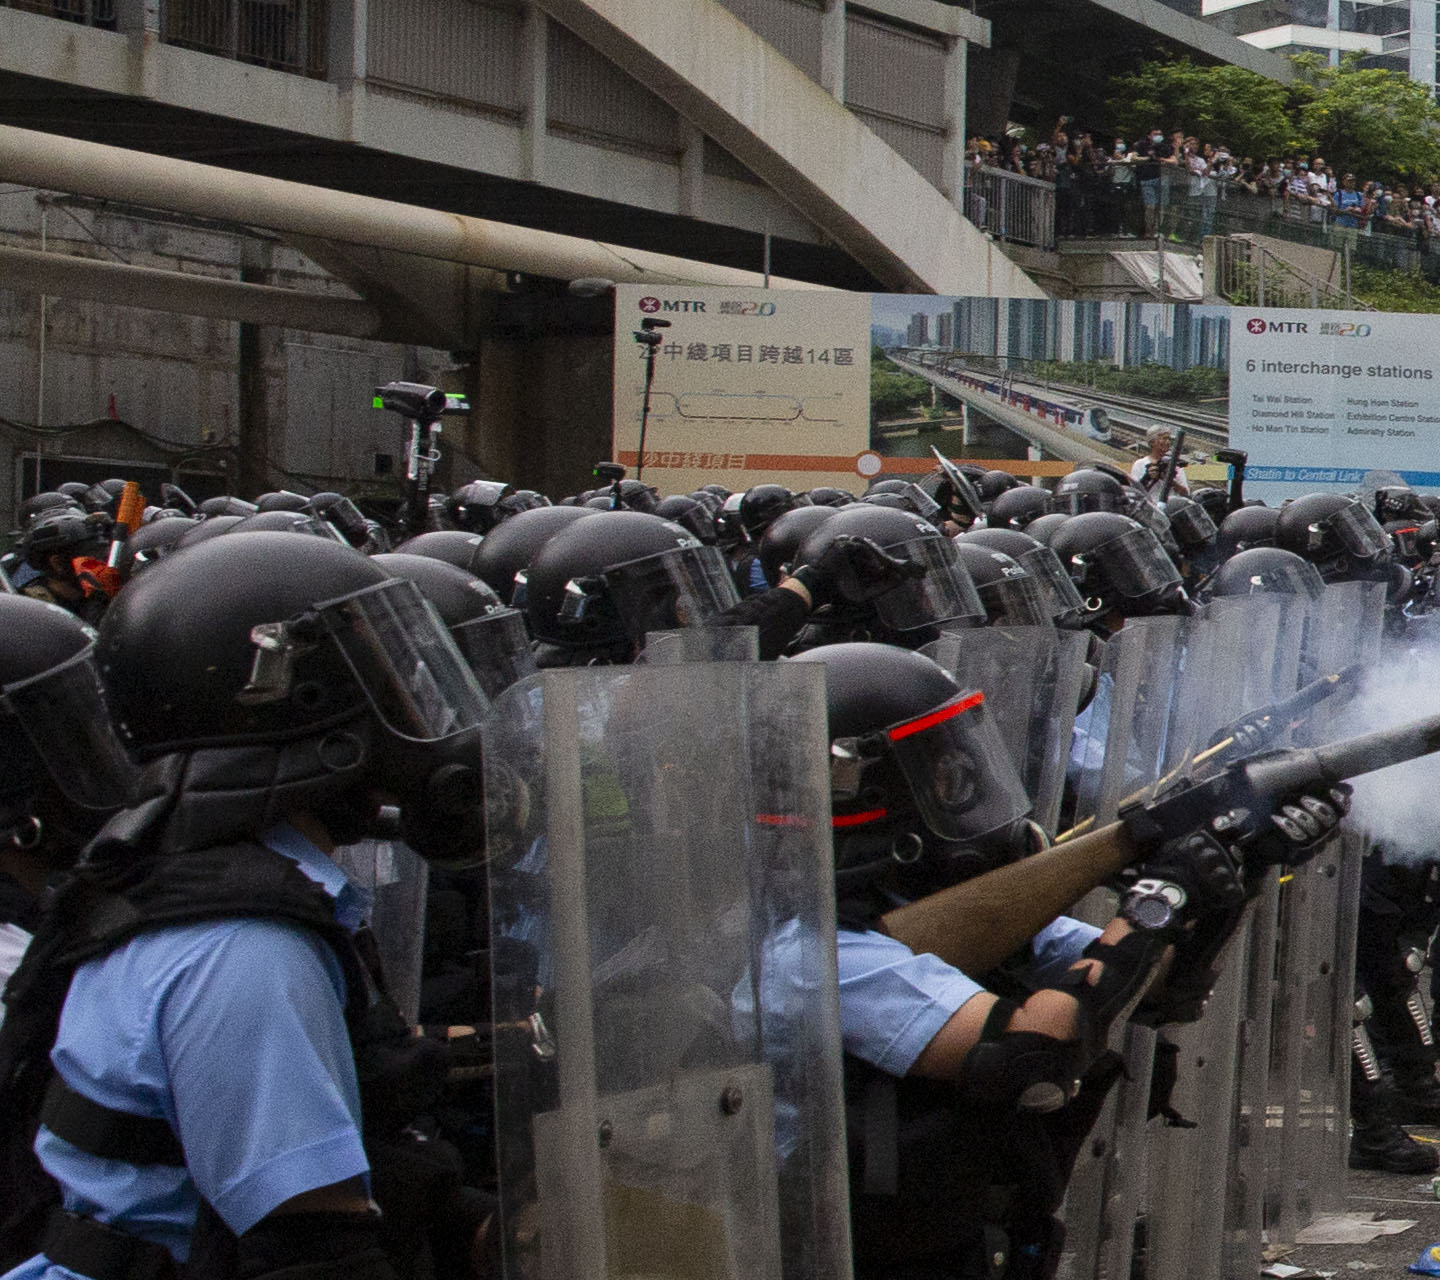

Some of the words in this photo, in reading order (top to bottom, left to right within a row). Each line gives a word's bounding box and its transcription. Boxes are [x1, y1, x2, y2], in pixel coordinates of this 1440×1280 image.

[662, 299, 706, 313] MTR
[1268, 321, 1308, 334] MTR
[1246, 359, 1256, 373] 6
[1261, 359, 1362, 379] interchange
[1366, 364, 1434, 380] stations
[1283, 395, 1313, 405] Station
[1347, 397, 1369, 408] Hung
[1391, 399, 1419, 408] Station
[1252, 409, 1289, 419] Diamond
[1306, 410, 1335, 420] Station
[1347, 412, 1387, 421] Exhibition
[1252, 424, 1264, 433] Ho
[1266, 425, 1283, 433] Man
[1300, 425, 1329, 435] Station
[1347, 426, 1385, 438] Admiralty
[1387, 428, 1415, 437] Station
[1298, 470, 1336, 481] Central
[1339, 471, 1362, 482] Link
